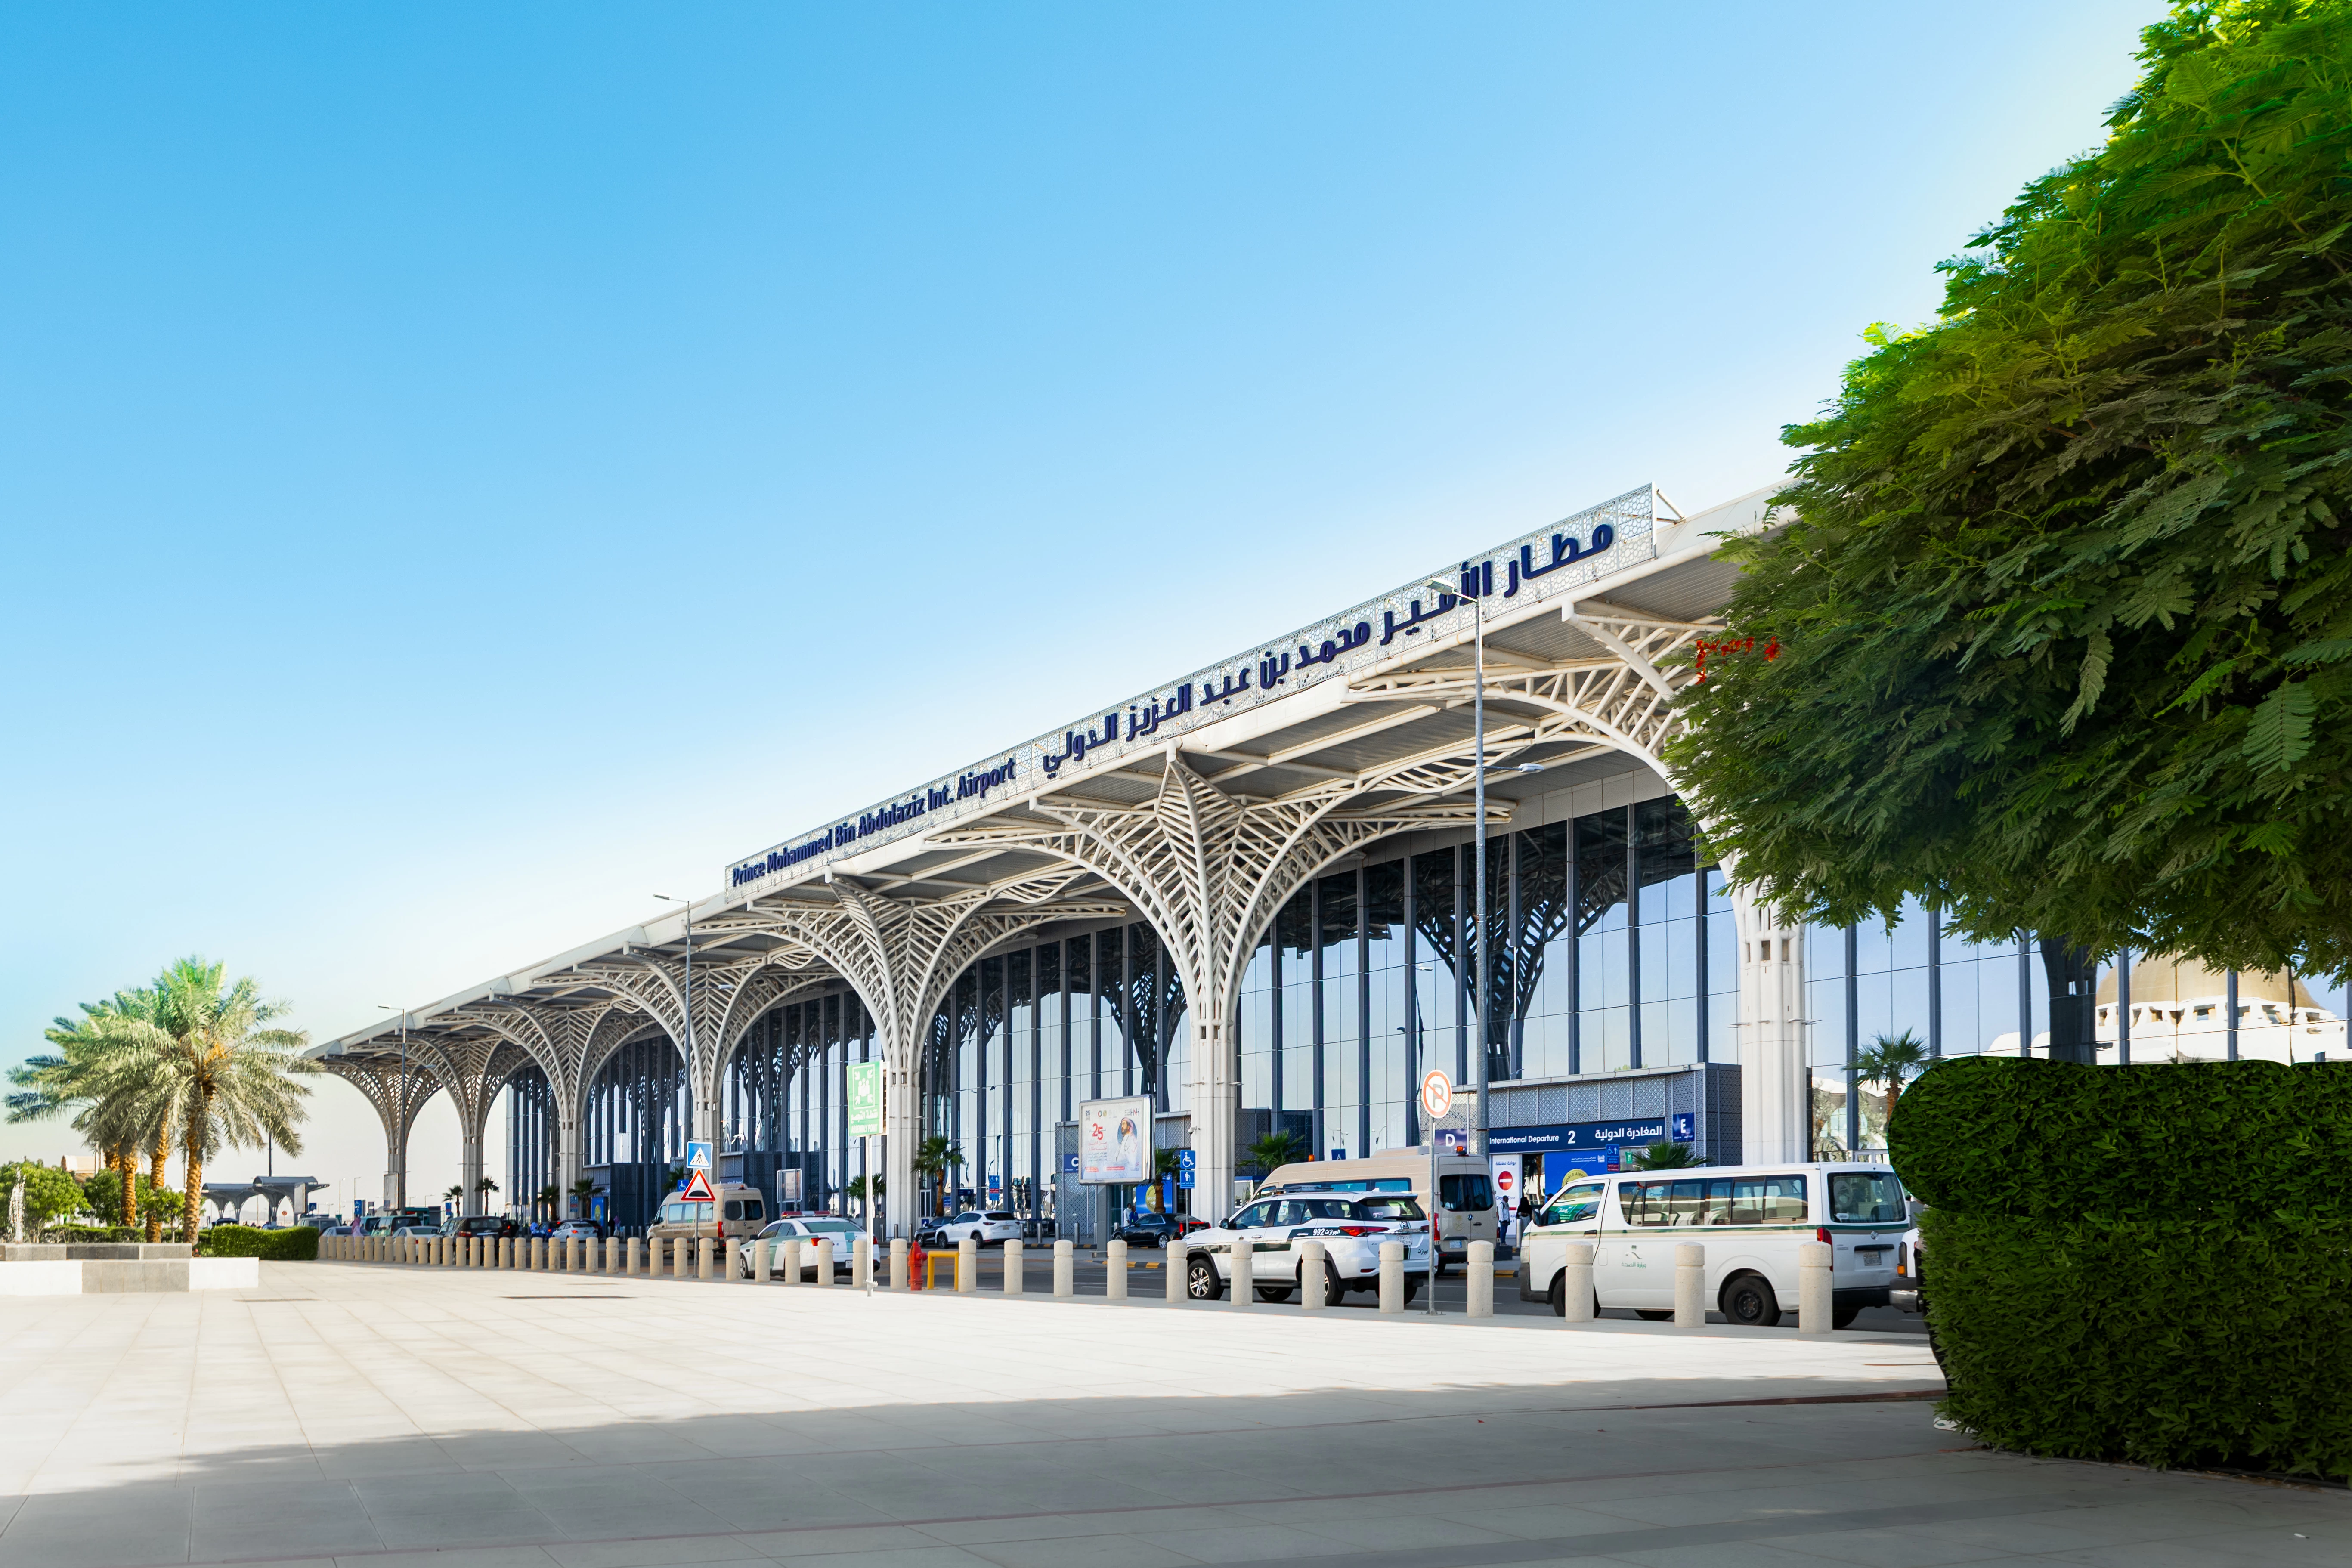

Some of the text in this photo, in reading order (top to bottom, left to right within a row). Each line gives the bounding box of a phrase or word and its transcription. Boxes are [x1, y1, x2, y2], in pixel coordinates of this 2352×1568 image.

[1043, 524, 1613, 779] مطار الأمير محمد بن عبد العزيز الدولي
[733, 758, 1015, 887] Prince Mohammed Bin Abdulaziz Int. Airport
[1092, 1123, 1103, 1140] 25
[1681, 1119, 1686, 1133] E
[1445, 1134, 1455, 1147] D
[1489, 1130, 1576, 1144] International Departure 2
[1595, 1126, 1662, 1141] المغادرة الدولية
[1071, 1157, 1079, 1167] C
